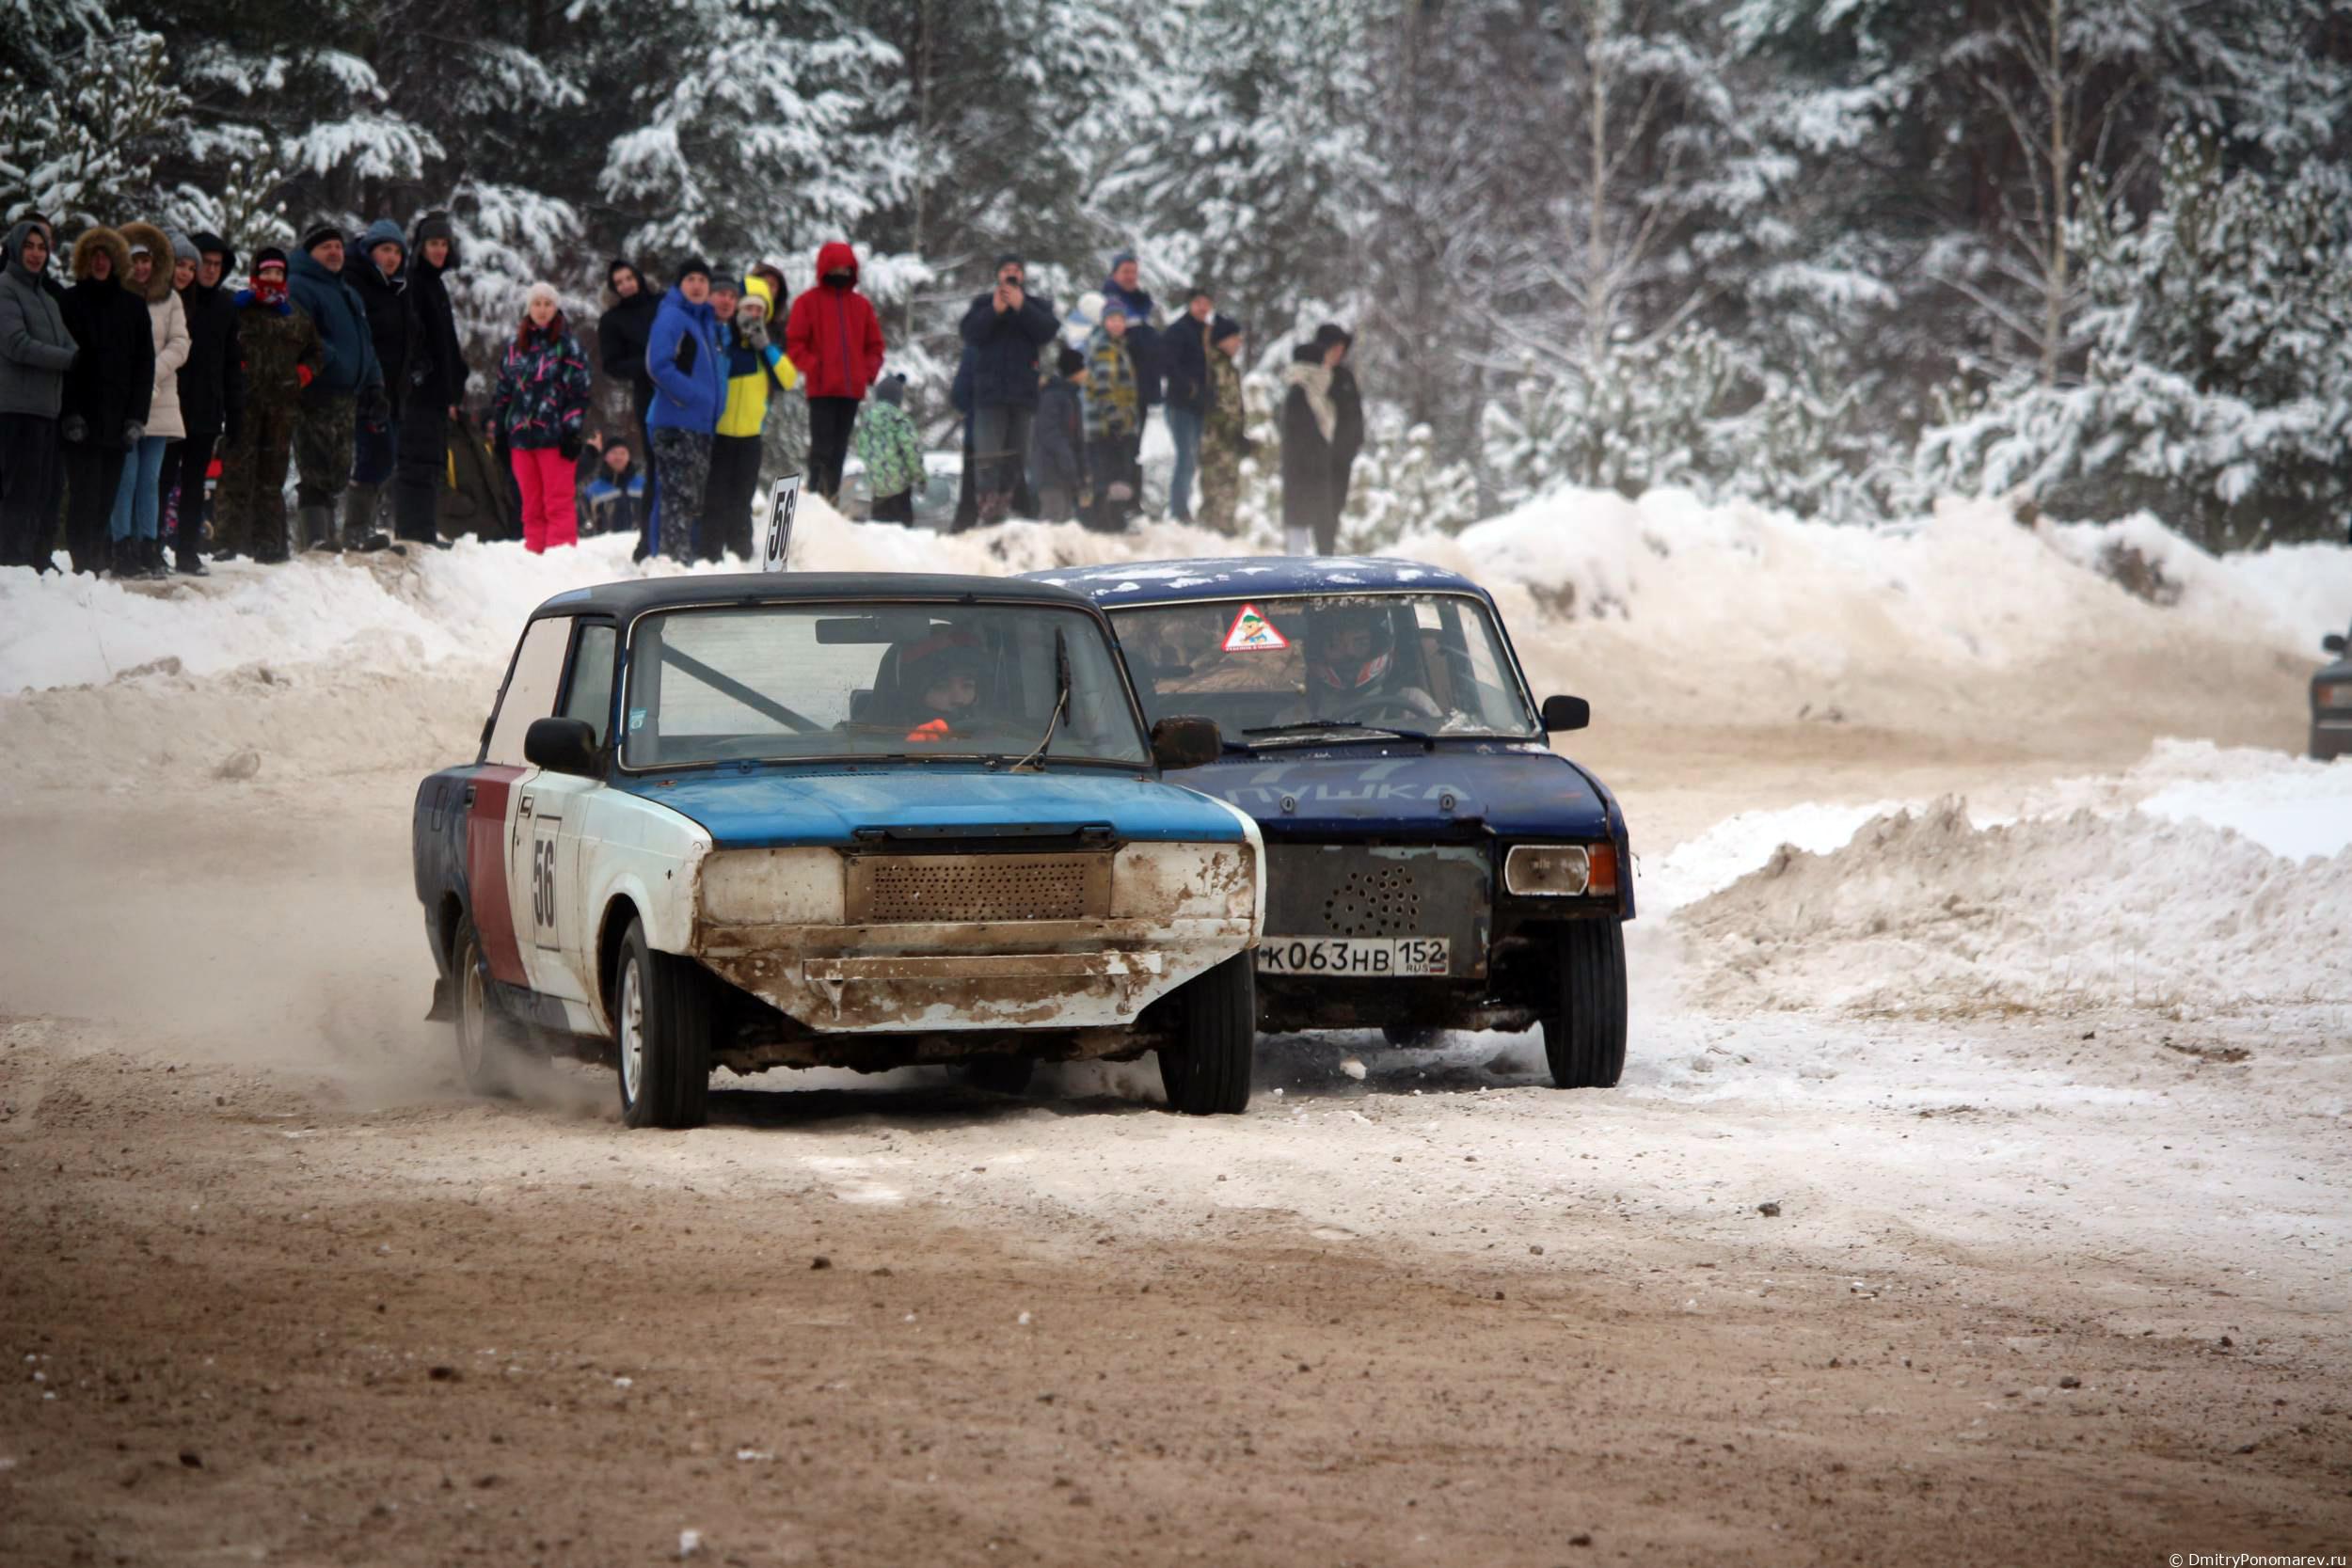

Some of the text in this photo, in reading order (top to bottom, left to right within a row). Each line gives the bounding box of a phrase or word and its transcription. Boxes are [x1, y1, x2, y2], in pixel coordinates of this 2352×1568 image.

[769, 488, 794, 562] 56
[1224, 783, 1471, 804] ПУШКА
[532, 839, 555, 928] 56
[1398, 942, 1443, 963] 152
[1406, 963, 1429, 973] RUS
